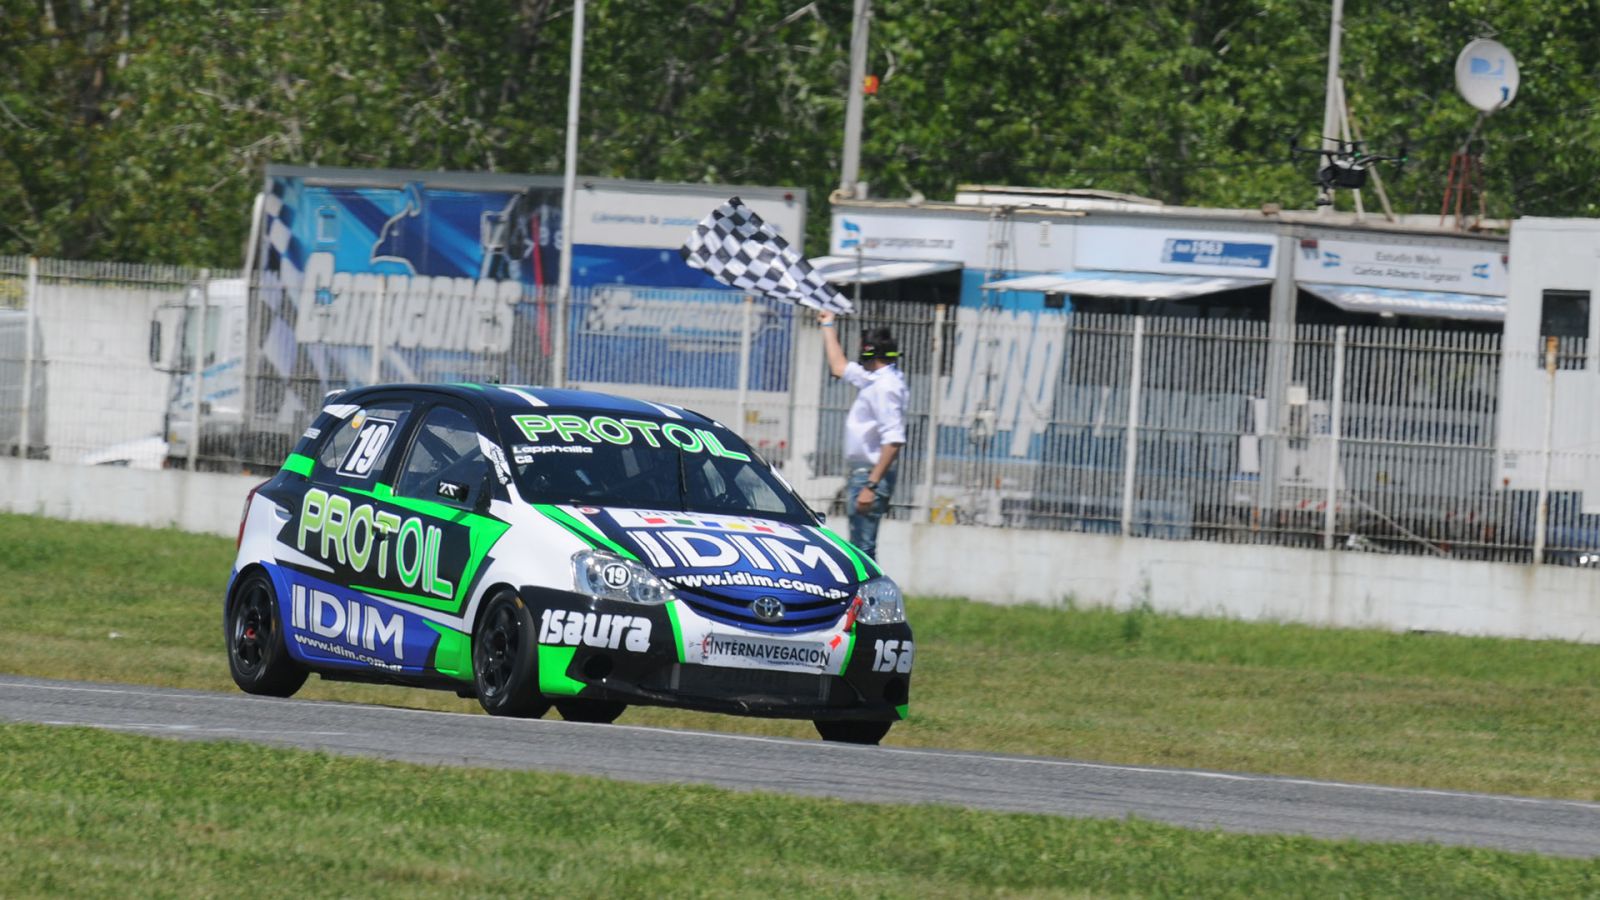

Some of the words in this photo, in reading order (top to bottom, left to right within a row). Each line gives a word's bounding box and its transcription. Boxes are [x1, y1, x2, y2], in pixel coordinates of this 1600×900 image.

[345, 424, 390, 474] 19
[511, 415, 751, 462] PROTOIL
[297, 488, 453, 599] PROTOIL
[625, 530, 851, 584] IDIM
[606, 566, 627, 585] 19
[291, 584, 404, 660] IDIM
[709, 636, 831, 666] INTERNAVEGACION
